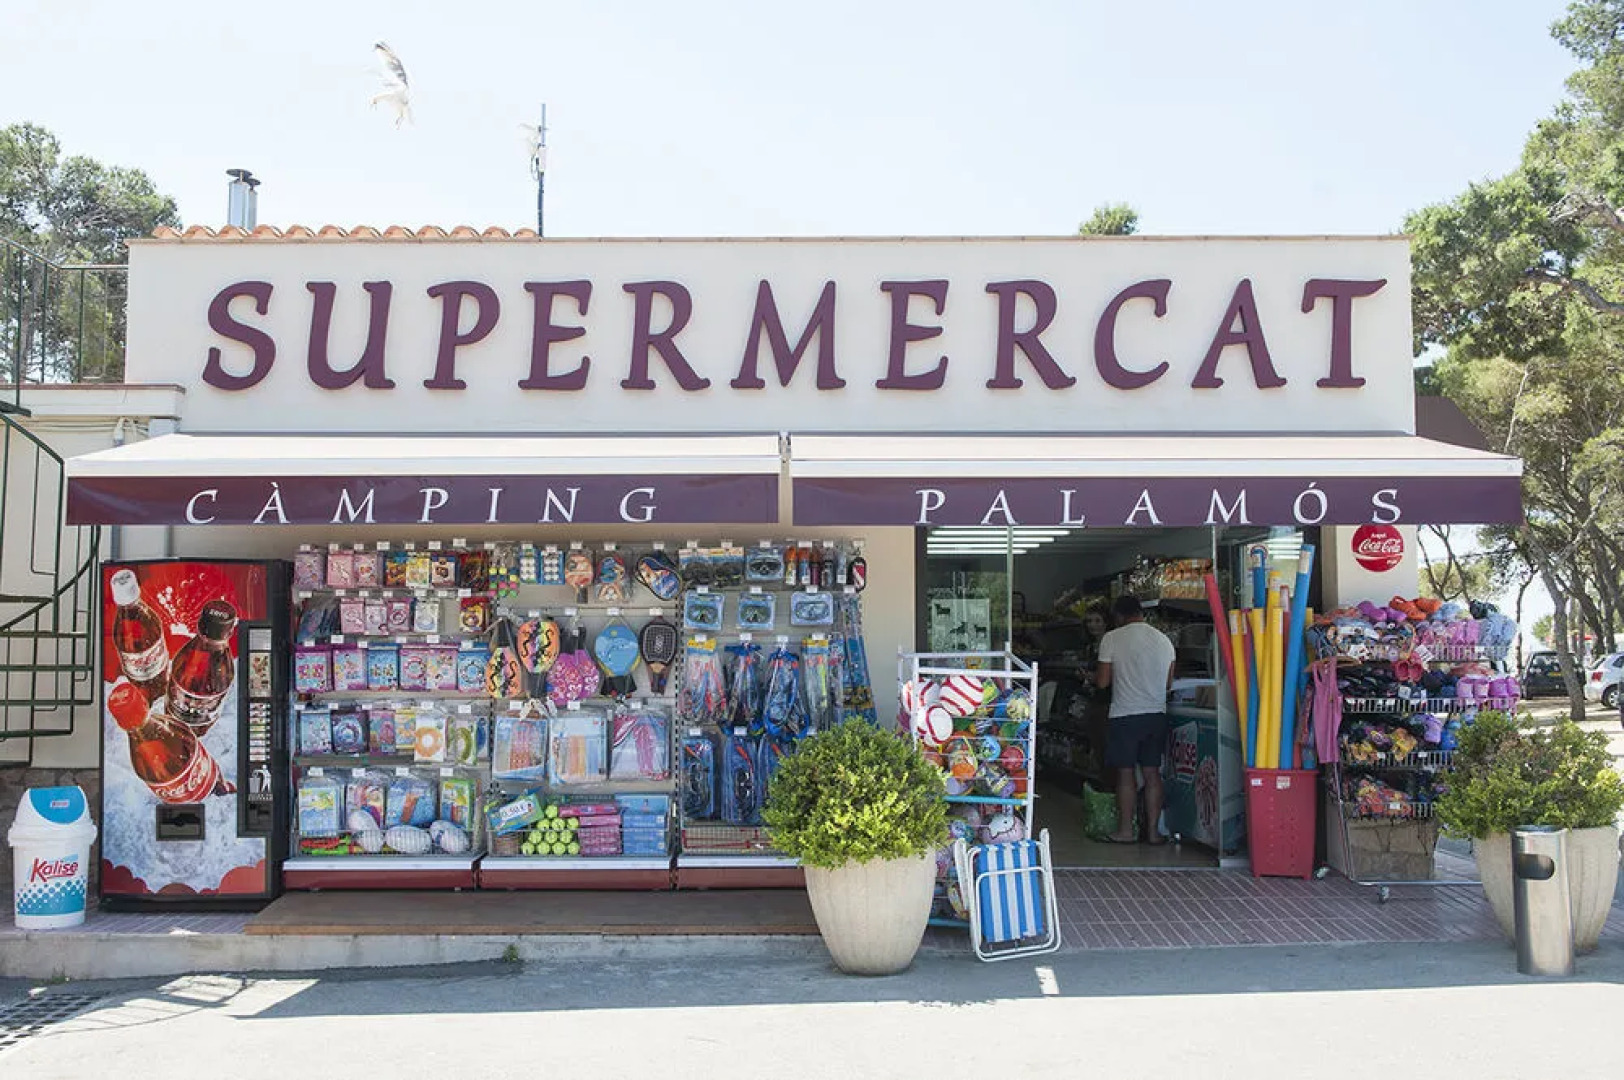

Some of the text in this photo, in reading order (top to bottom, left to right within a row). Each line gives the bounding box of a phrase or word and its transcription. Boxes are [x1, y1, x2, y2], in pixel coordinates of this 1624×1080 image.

[202, 279, 1387, 391] SUPERMERCAT
[185, 481, 658, 525] CÀMPING
[914, 481, 1402, 526] PALAMÓS
[30, 858, 79, 883] Kalise
